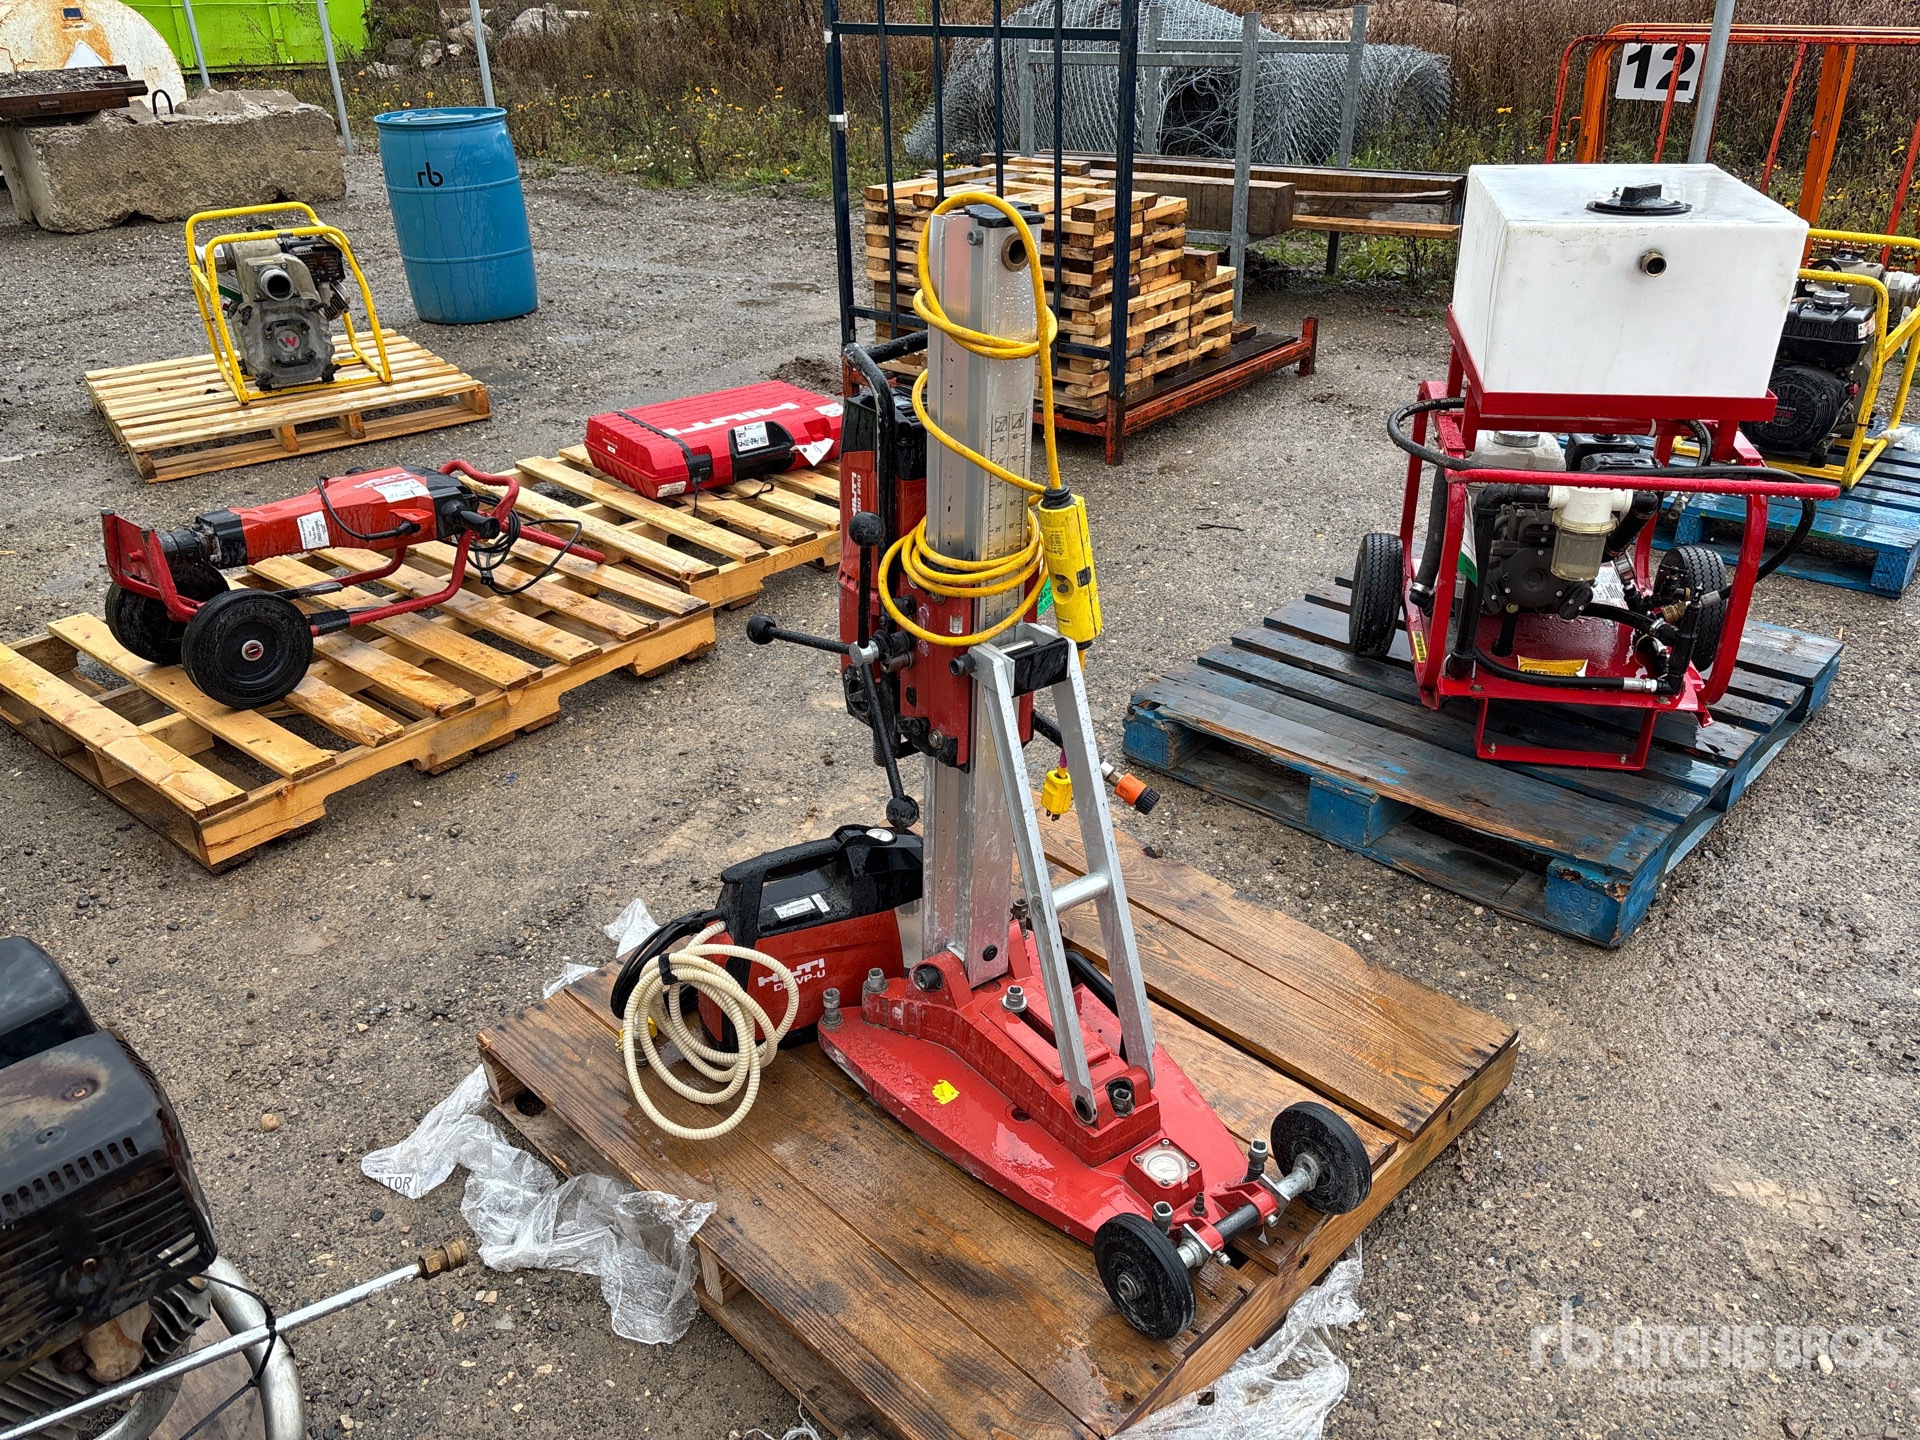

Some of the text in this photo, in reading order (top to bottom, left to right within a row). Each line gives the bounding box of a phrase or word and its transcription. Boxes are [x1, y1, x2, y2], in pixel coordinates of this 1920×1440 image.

[1627, 45, 1695, 91] 12
[417, 161, 444, 187] rb
[662, 402, 801, 436] HILTI
[757, 958, 825, 987] HLTI
[795, 969, 826, 985] VP-U
